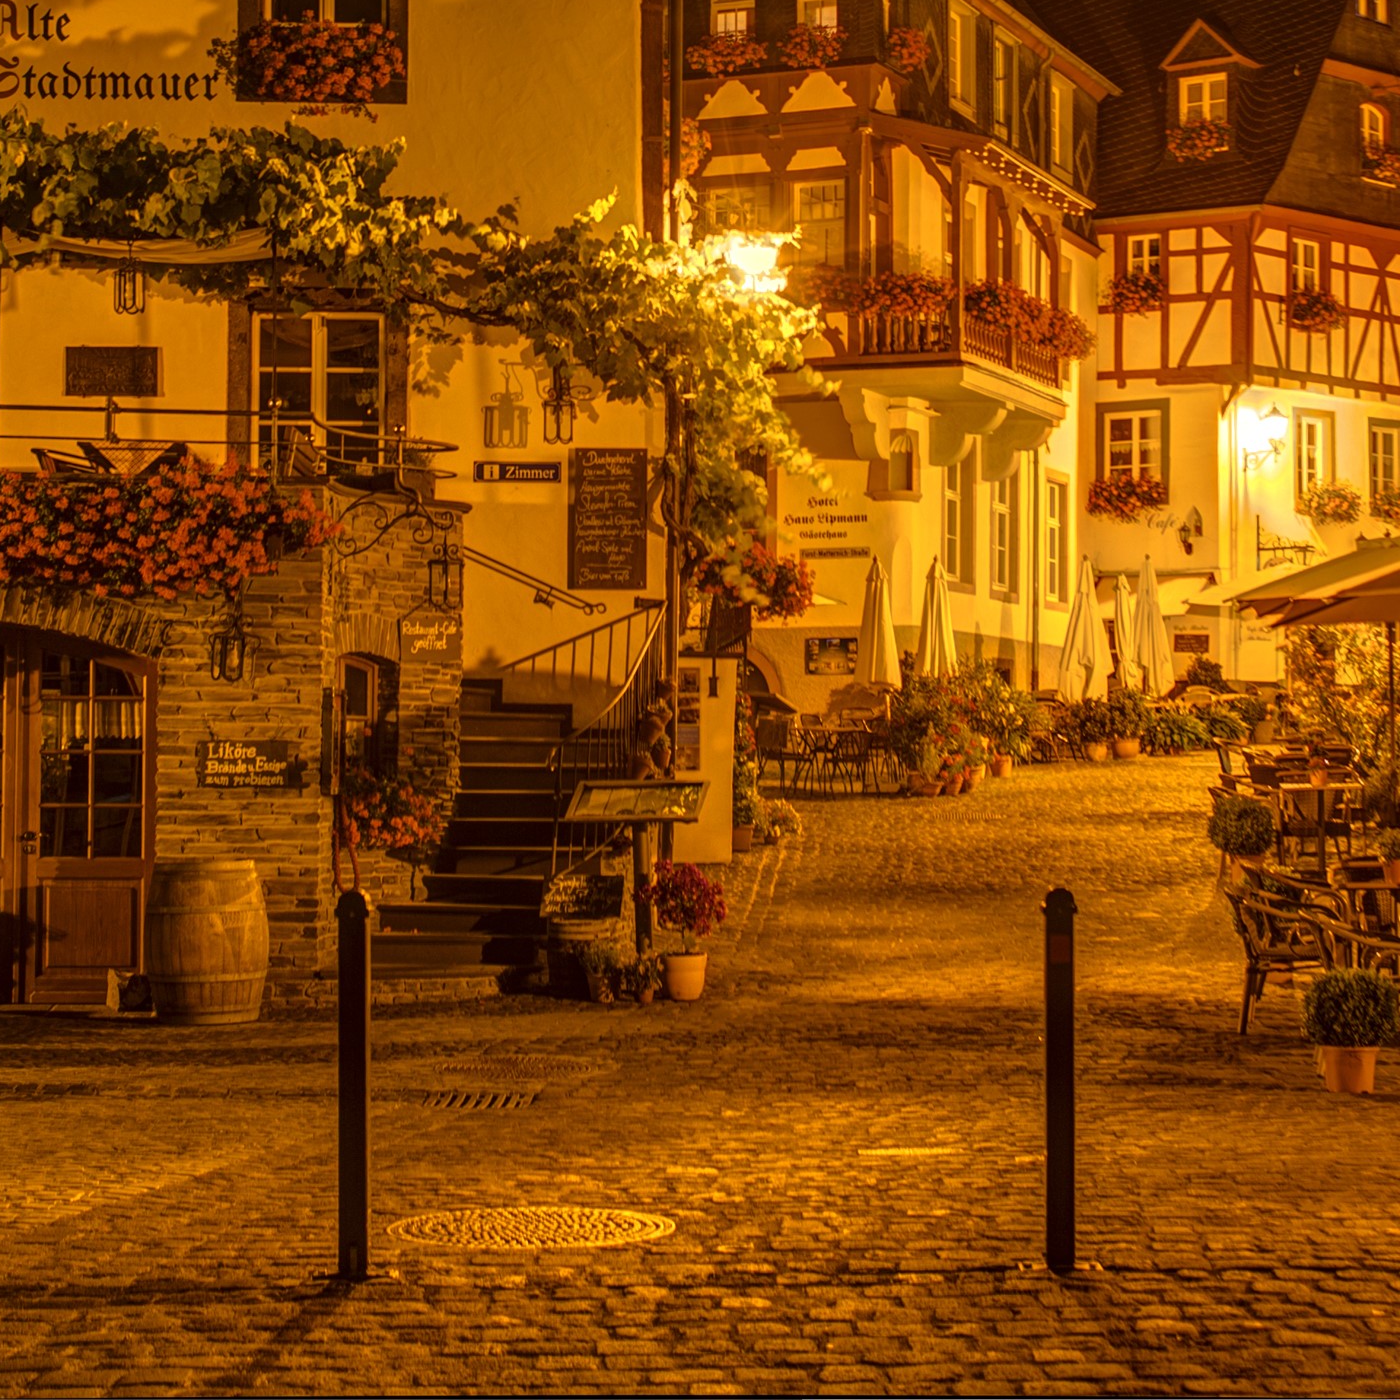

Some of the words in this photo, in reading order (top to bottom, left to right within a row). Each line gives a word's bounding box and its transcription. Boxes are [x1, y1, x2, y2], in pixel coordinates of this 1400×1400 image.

[505, 466, 555, 479] Zimmer
[807, 496, 838, 509] Hotel
[784, 514, 814, 526] Haus
[818, 512, 868, 526] Lipmann
[207, 742, 257, 760] Liköre
[205, 760, 247, 774] Brände
[255, 756, 287, 773] Essige
[205, 776, 229, 786] zum
[233, 772, 284, 786] probieren
